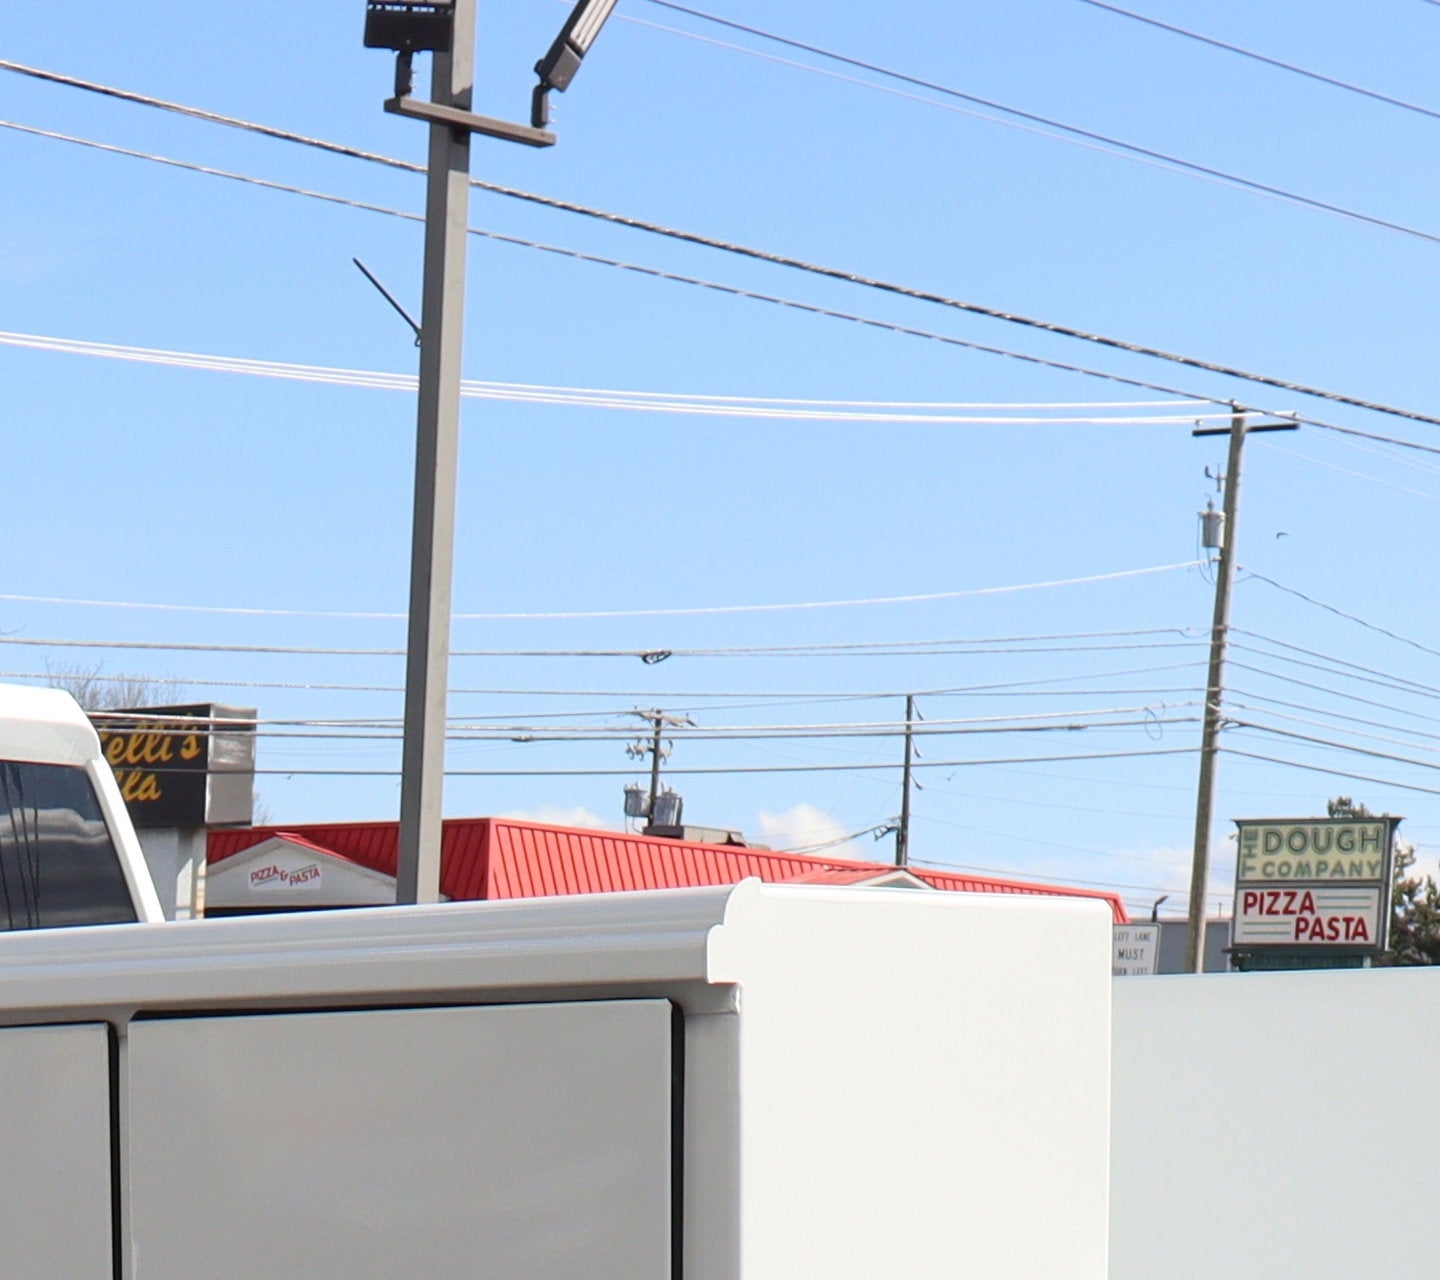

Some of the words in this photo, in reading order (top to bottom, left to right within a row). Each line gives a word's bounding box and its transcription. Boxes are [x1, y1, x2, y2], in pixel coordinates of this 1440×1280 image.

[102, 718, 200, 766] elli's
[1242, 828, 1259, 878] THE
[1262, 826, 1383, 855] DOUGH
[250, 865, 278, 882] PIZZA
[280, 870, 288, 880] &
[289, 867, 320, 886] PASTA
[1262, 860, 1381, 878] COMPANY
[1243, 891, 1315, 916] PIZZA
[1294, 916, 1369, 942] PASTA
[1118, 948, 1144, 960] MUST
